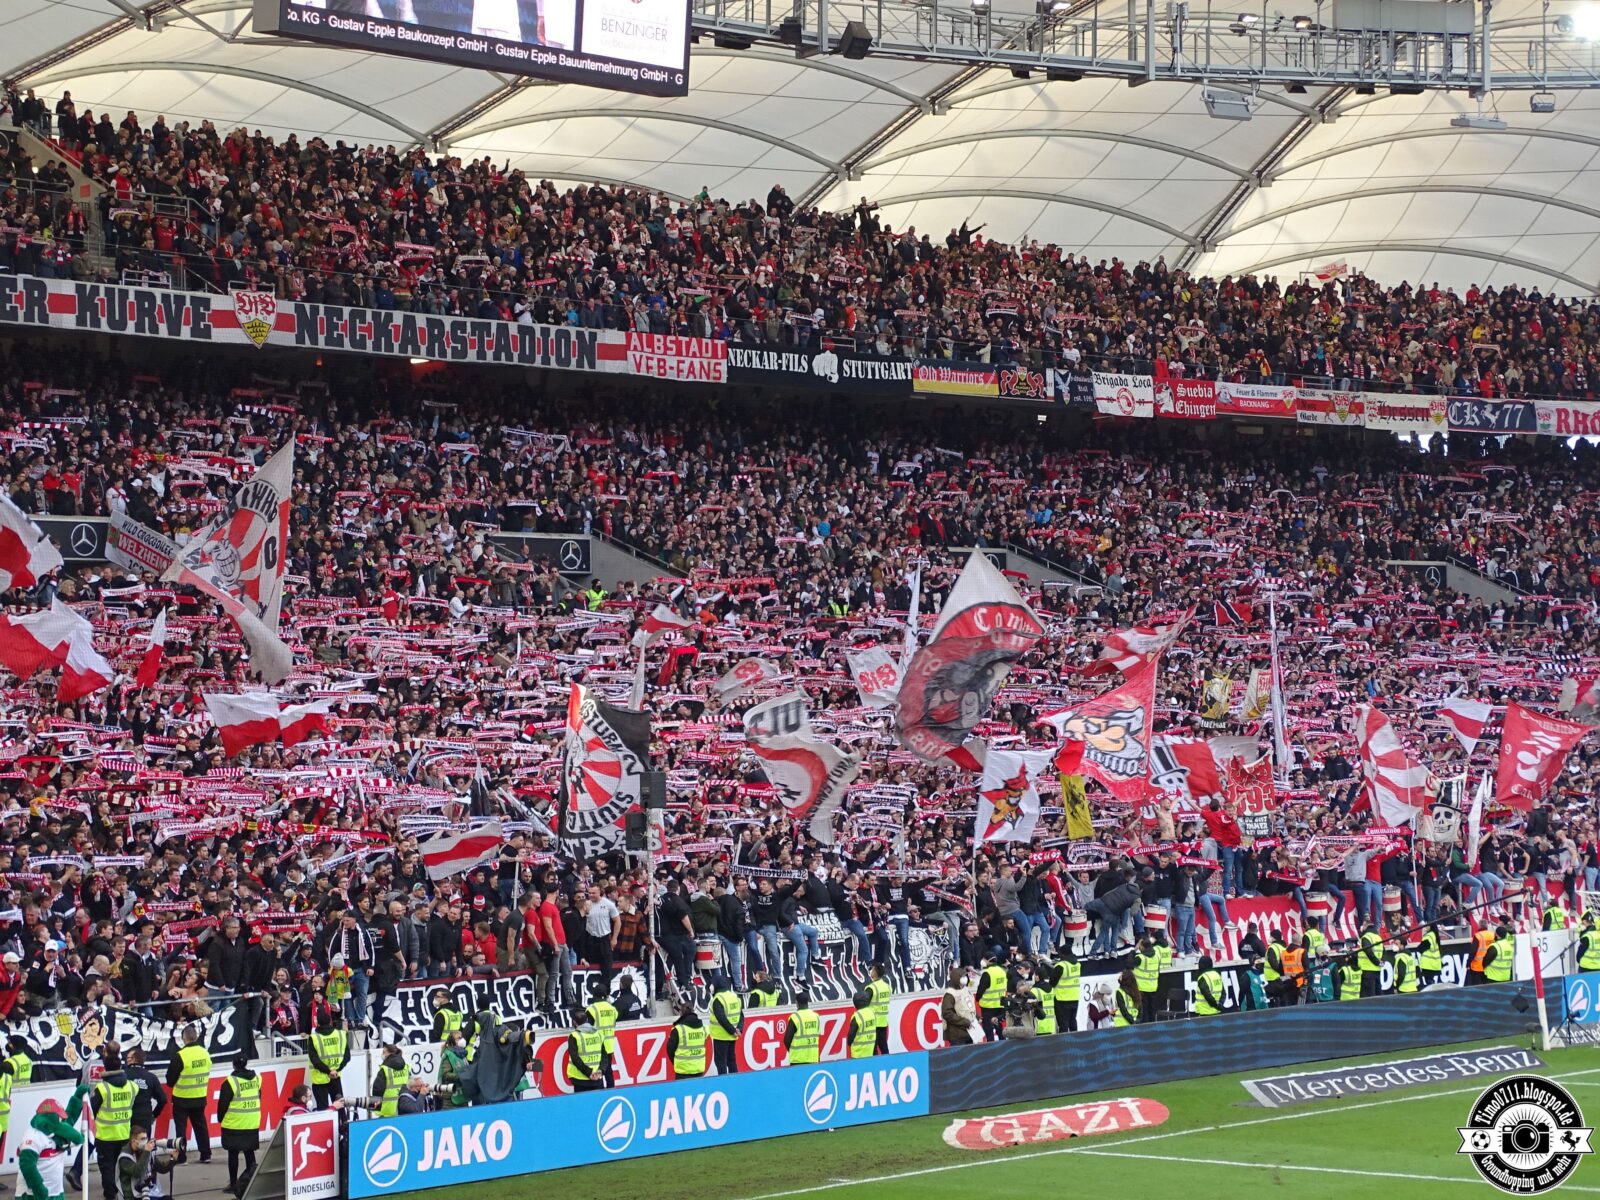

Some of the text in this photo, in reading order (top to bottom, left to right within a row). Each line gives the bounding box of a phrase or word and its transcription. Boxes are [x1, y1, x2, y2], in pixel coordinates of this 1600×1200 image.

[601, 18, 668, 42] BENZINGER
[302, 11, 320, 25] KG
[328, 14, 364, 32] Gustav
[367, 22, 395, 38] Epple
[398, 26, 459, 48] Baukonzept
[457, 38, 487, 53] GmbH
[495, 43, 528, 60] Gustav
[531, 50, 557, 65] Epple
[559, 54, 638, 81] Bauunternehmung
[640, 68, 668, 83] GmbH
[675, 74, 683, 85] G
[75, 283, 212, 340] KURVE
[295, 302, 598, 370] NECKARSTADION
[629, 333, 725, 359] ALBSTADT
[632, 354, 722, 382] VFB-FANS
[728, 348, 913, 381] NECKAR-FILS STUTTGART
[918, 366, 985, 385] Old Warriors
[1094, 373, 1128, 389] Brigada
[1176, 383, 1213, 399] Suebia
[1175, 400, 1216, 418] Ehingen
[1378, 400, 1429, 425] Hessen
[1502, 404, 1525, 429] 77
[411, 1051, 435, 1075] 33
[1262, 1049, 1541, 1103] Mercedes-Benz
[845, 1066, 919, 1111] JAKO
[644, 1090, 729, 1139] JAKO
[417, 1119, 513, 1172] JAKO
[292, 1180, 336, 1197] BUNDESLIGA
